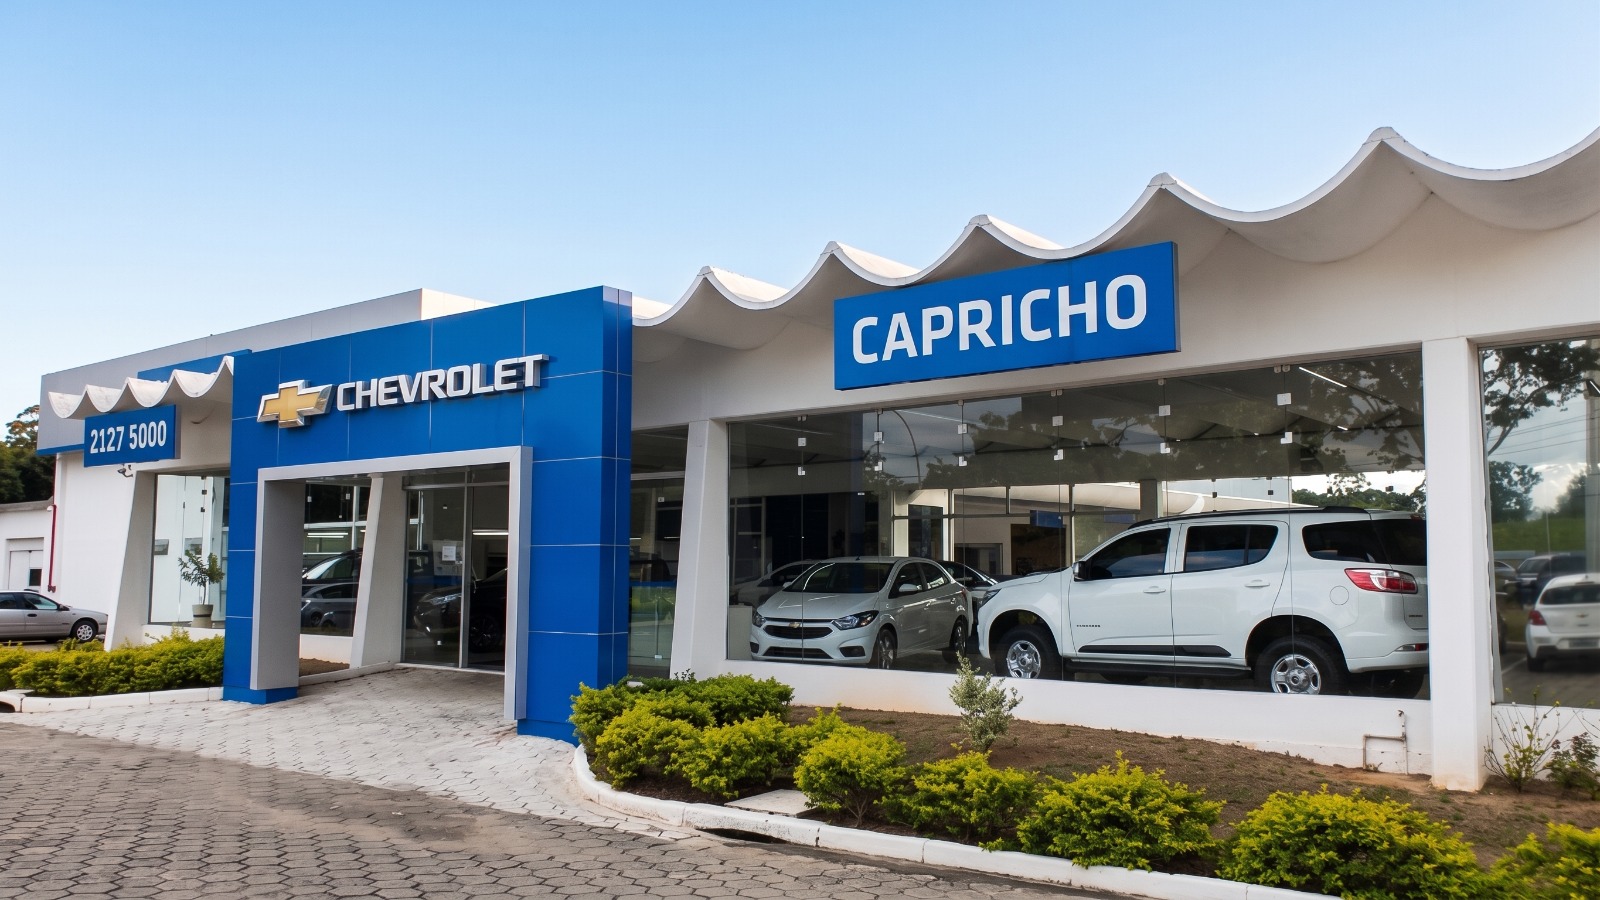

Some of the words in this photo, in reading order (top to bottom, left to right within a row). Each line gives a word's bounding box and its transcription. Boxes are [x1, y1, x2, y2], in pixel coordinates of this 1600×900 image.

[852, 274, 1147, 364] CAPRICHO
[336, 354, 549, 412] CHEVROLET
[90, 426, 125, 454] 2127
[129, 420, 167, 450] 5000
